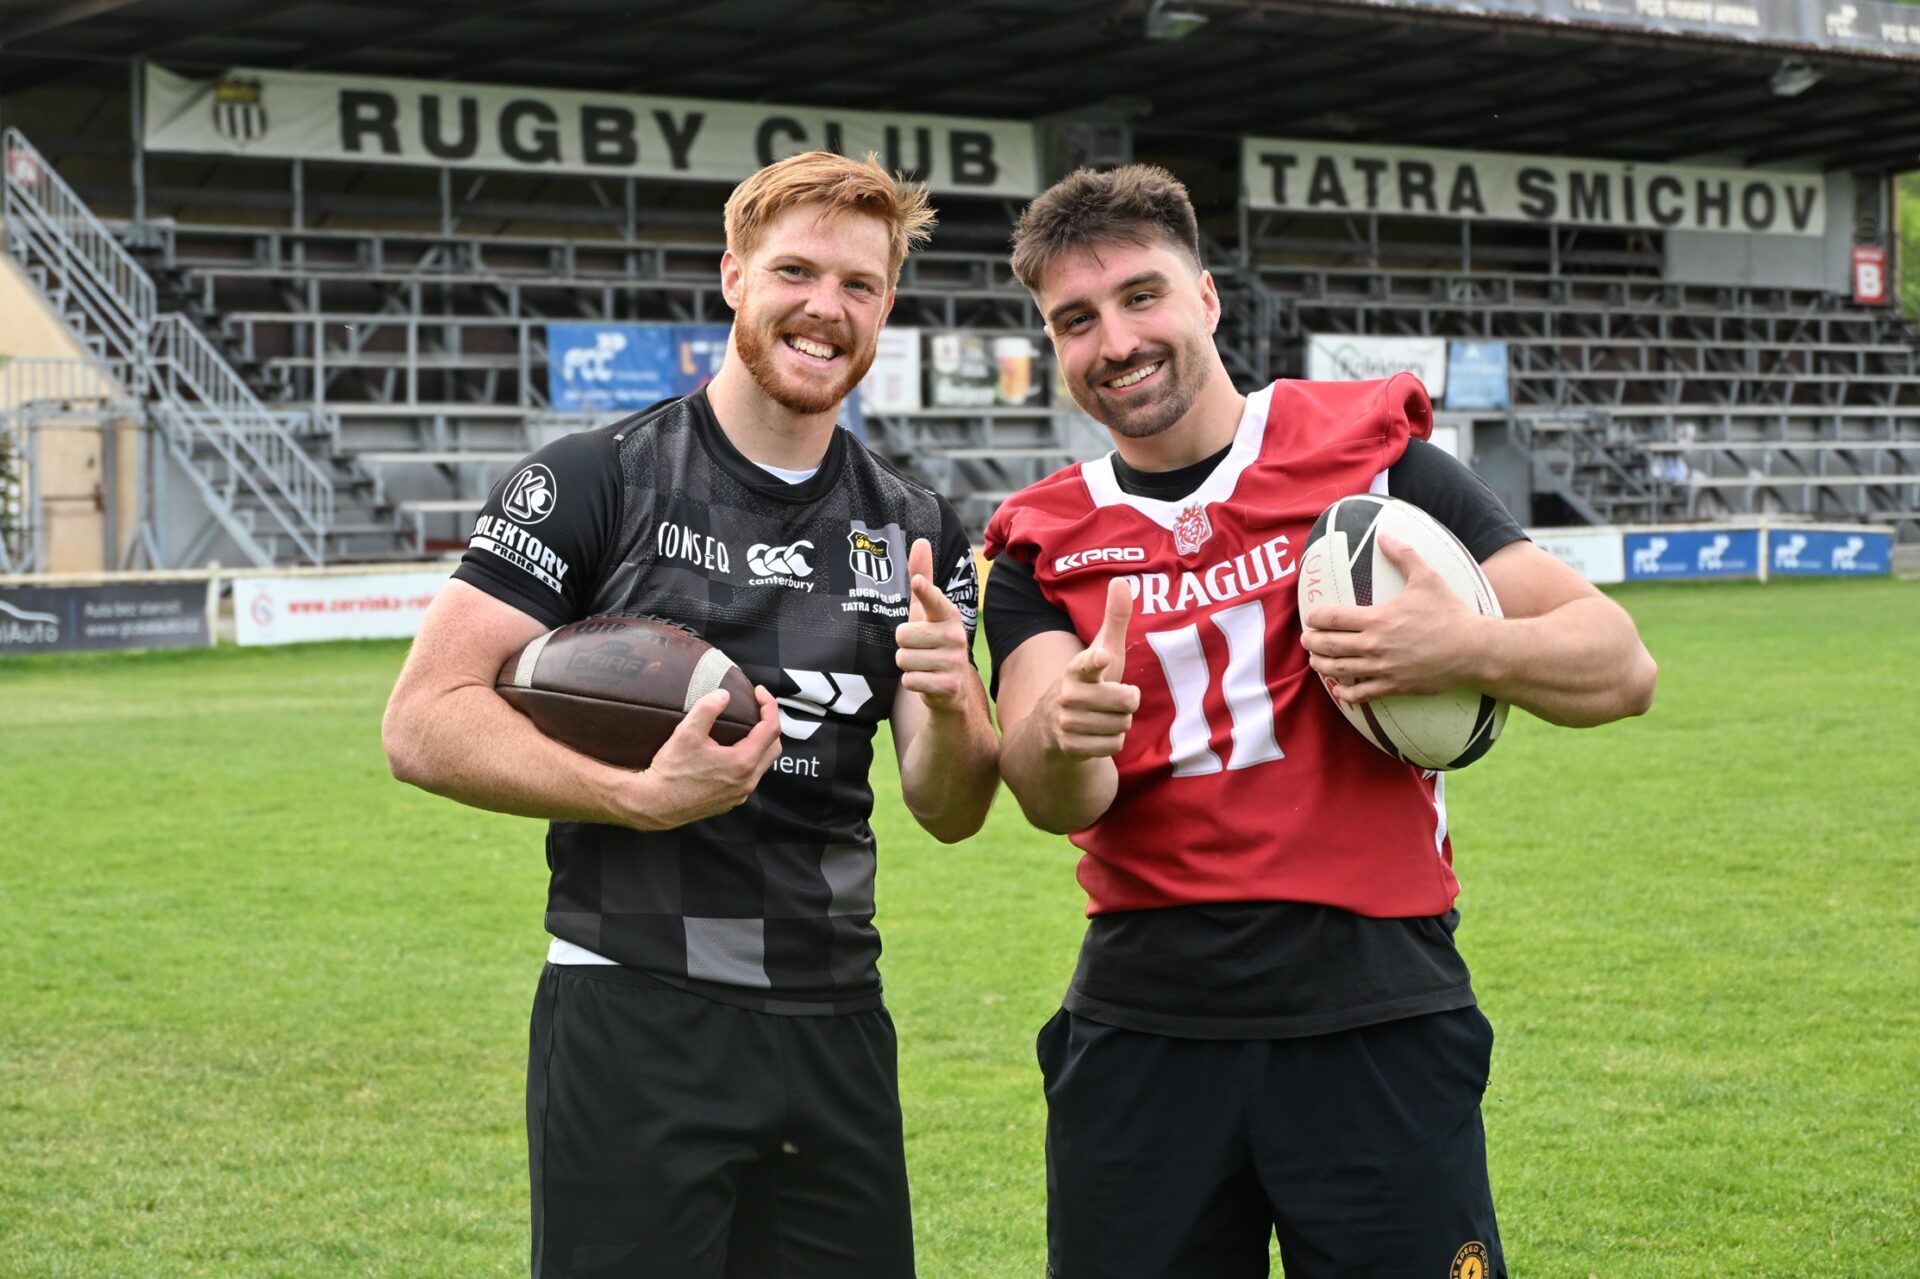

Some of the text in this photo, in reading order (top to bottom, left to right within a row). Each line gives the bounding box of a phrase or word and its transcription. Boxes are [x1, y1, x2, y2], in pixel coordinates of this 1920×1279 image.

[339, 89, 709, 172] RUGBY
[1259, 153, 1817, 232] TATRA SMÍCHOV
[1857, 264, 1881, 297] B
[658, 521, 731, 574] CONSEQ
[748, 576, 815, 593] canterbury
[849, 588, 881, 599] RUGBY
[1306, 554, 1324, 604] U16
[841, 602, 871, 613] TATRA
[1146, 600, 1285, 777] 11
[1456, 1245, 1479, 1265] SPEED
